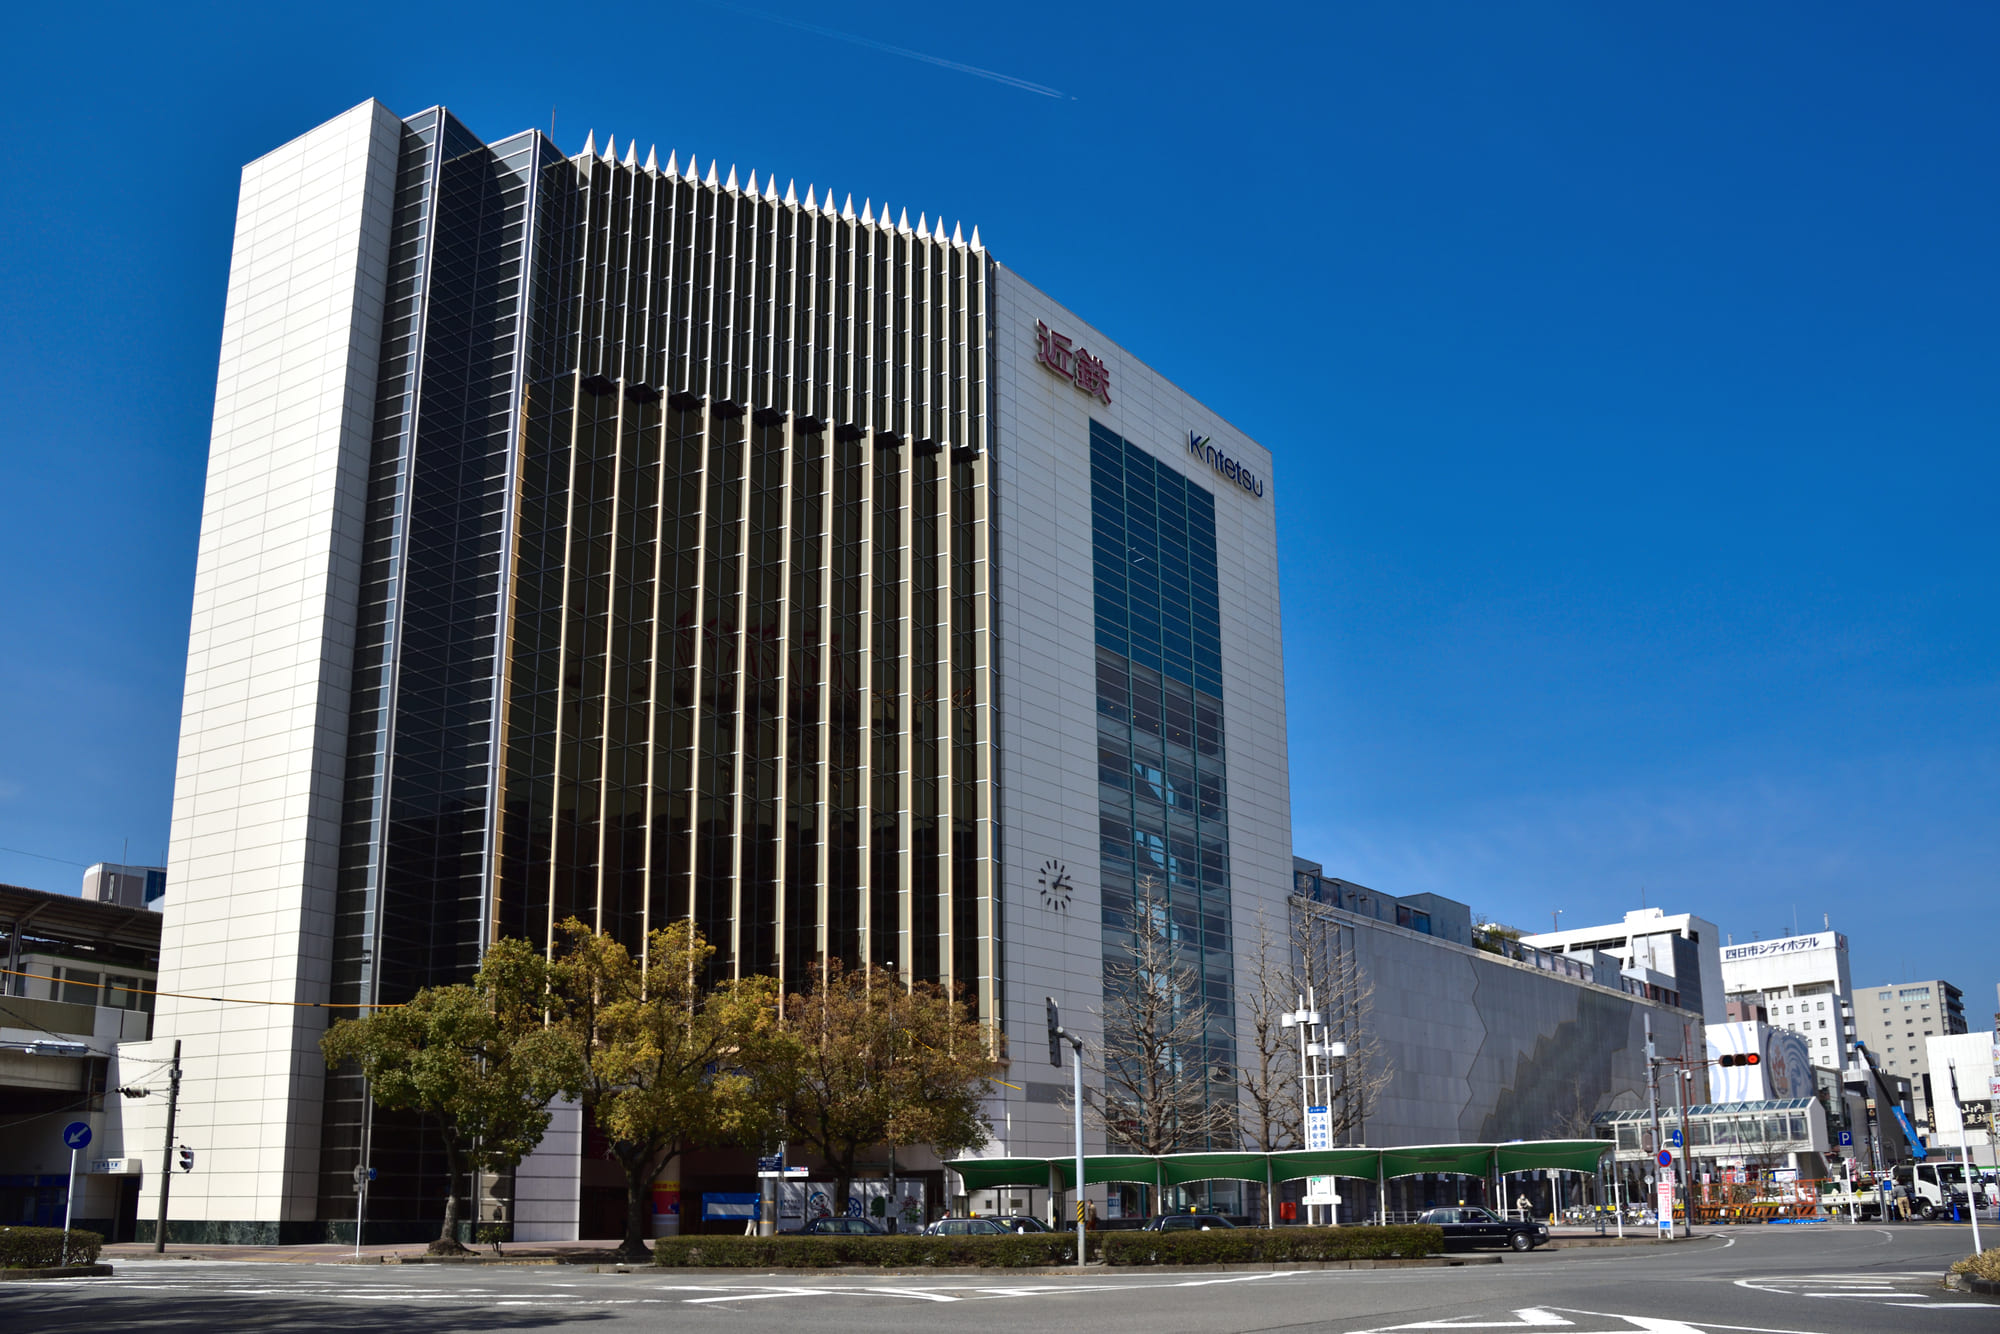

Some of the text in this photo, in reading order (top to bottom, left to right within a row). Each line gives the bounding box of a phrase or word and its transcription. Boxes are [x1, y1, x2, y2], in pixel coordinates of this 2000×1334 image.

[1036, 318, 1112, 406] 近鉄
[1725, 937, 1820, 959] 四日市シティホテル
[1842, 1132, 1850, 1144] P
